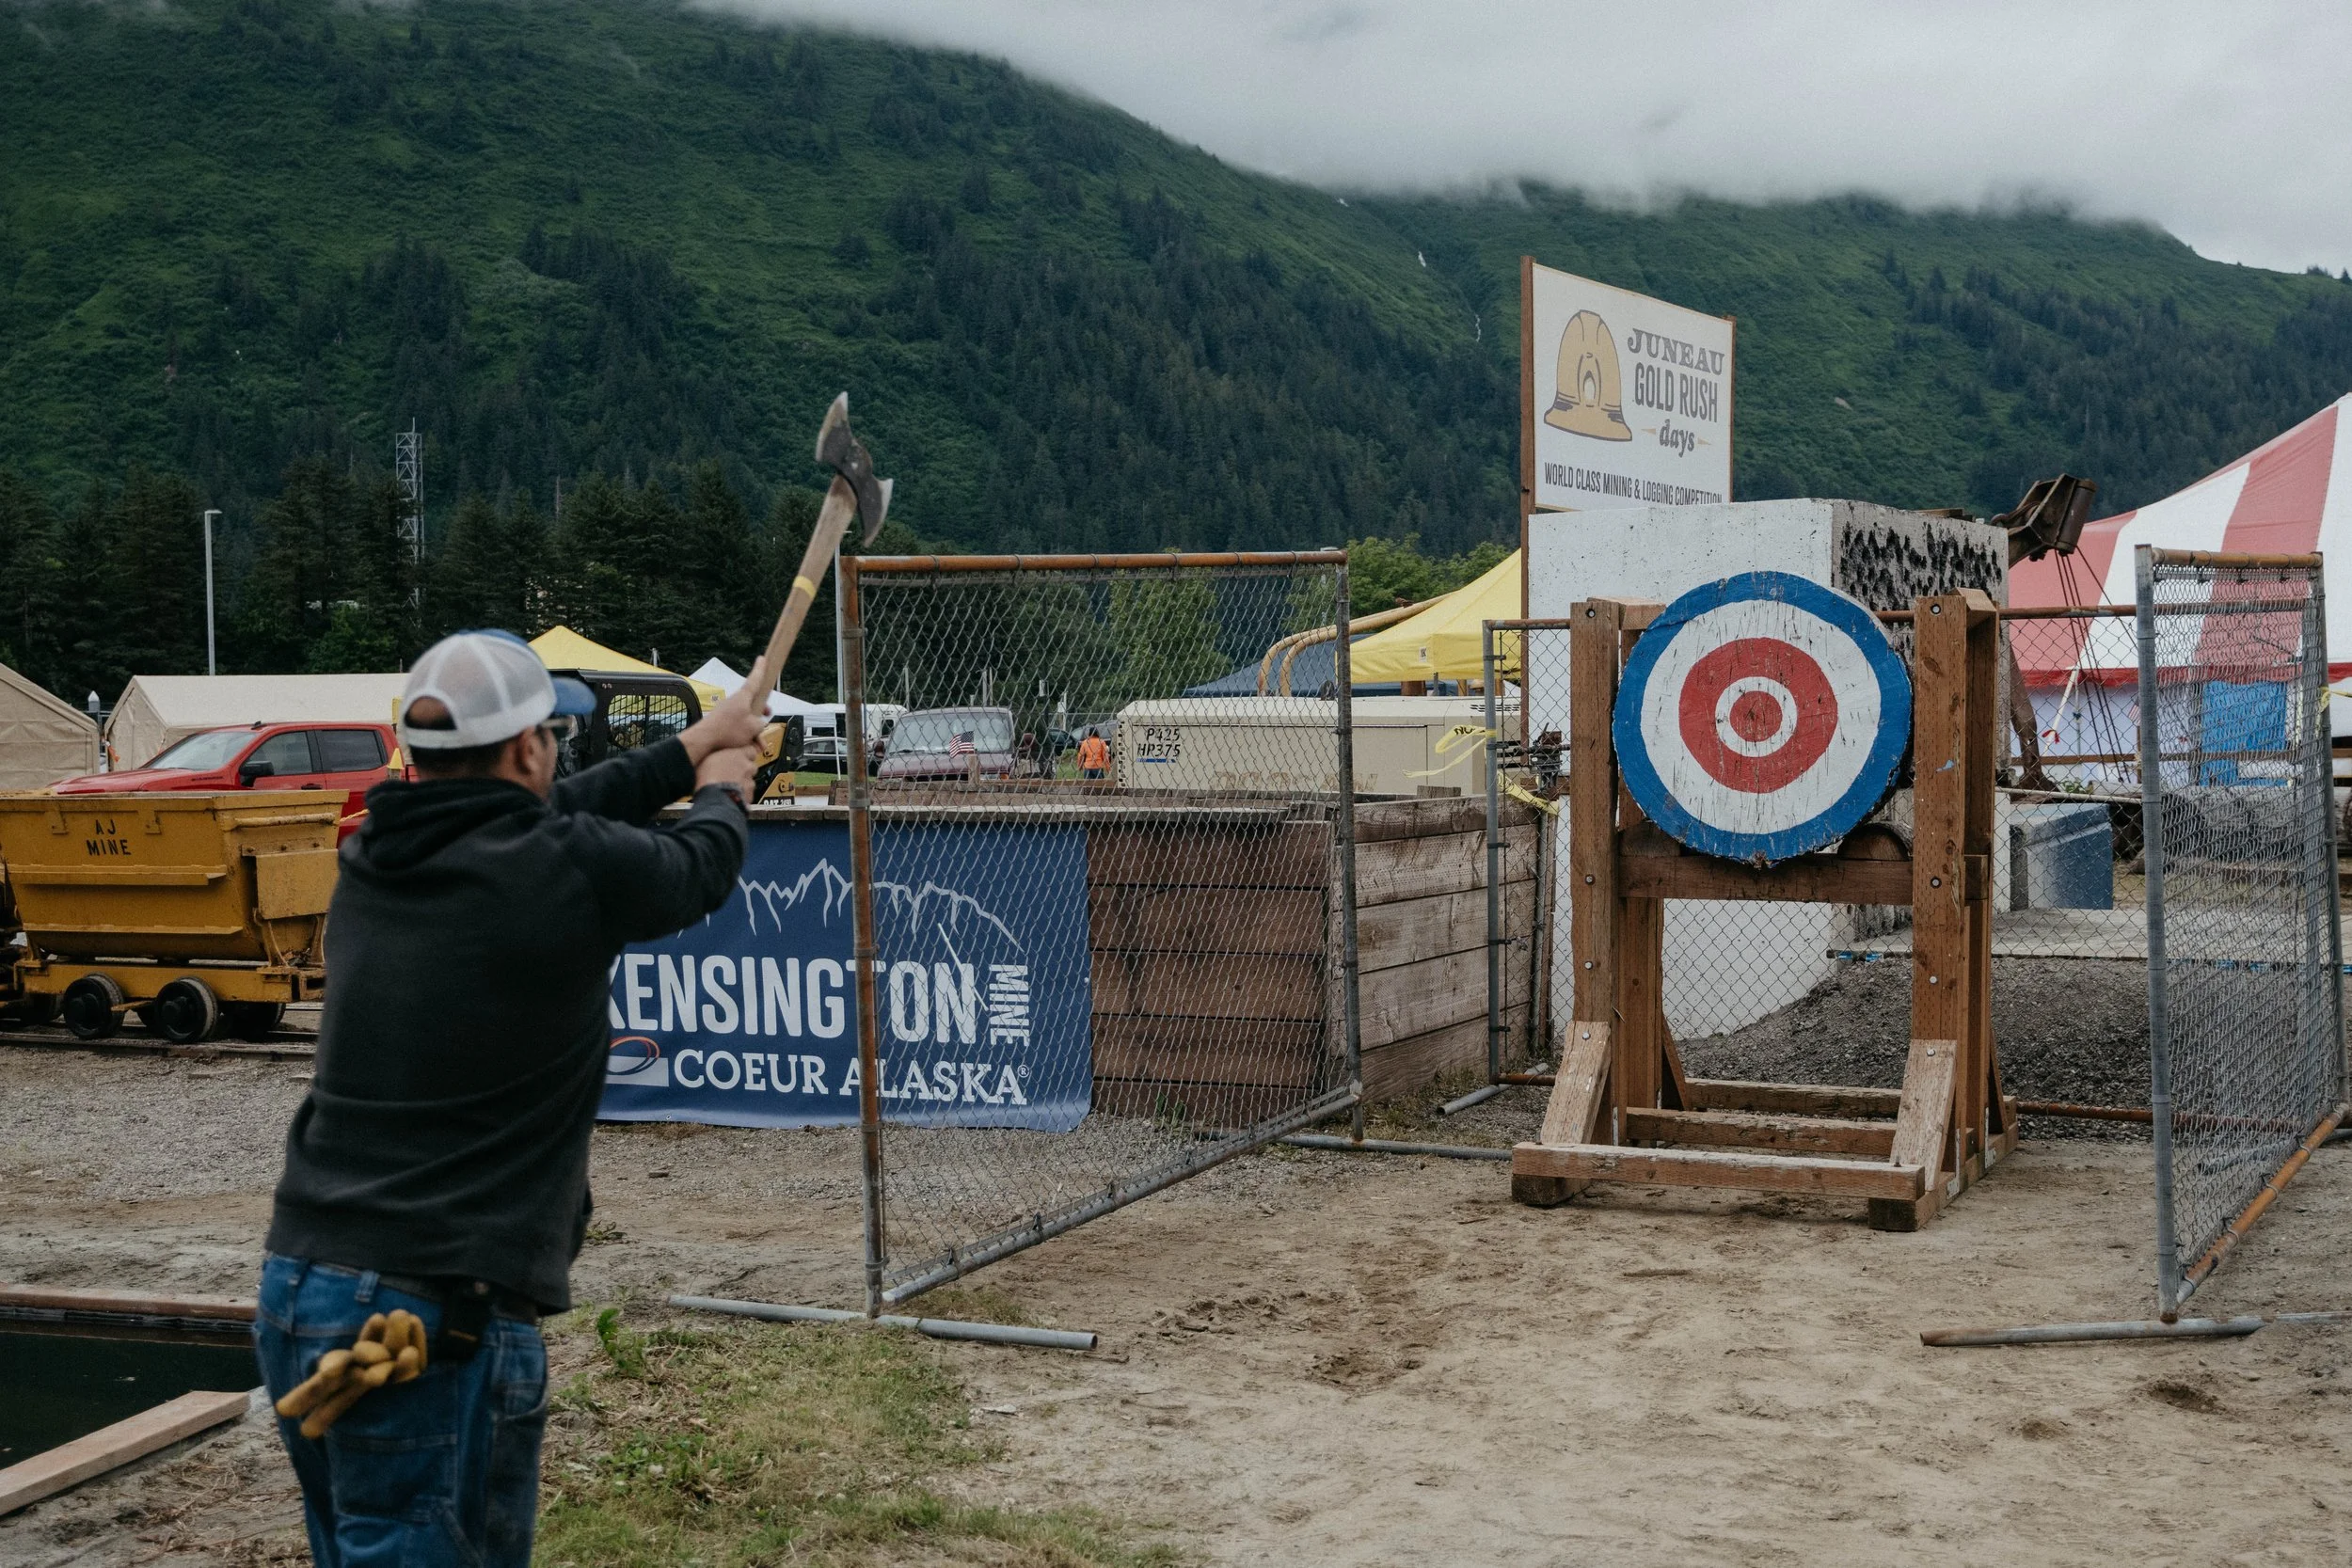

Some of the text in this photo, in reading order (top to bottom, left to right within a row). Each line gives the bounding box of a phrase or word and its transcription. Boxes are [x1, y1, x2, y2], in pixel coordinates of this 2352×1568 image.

[1627, 327, 1725, 375] JUNEAU
[1634, 361, 1718, 423] GOLD RUSH
[1659, 419, 1695, 458] days
[1544, 461, 1574, 488] WORLD
[1575, 467, 1601, 493] CLASS
[1603, 472, 1632, 499] MINING
[1634, 478, 1641, 500] &
[1642, 479, 1673, 505] LOGGING
[1137, 743, 1181, 757] HP375
[1146, 727, 1180, 741] P425
[86, 838, 132, 856] MINE
[989, 964, 1030, 1047] MINE
[674, 1048, 830, 1096] COEUR
